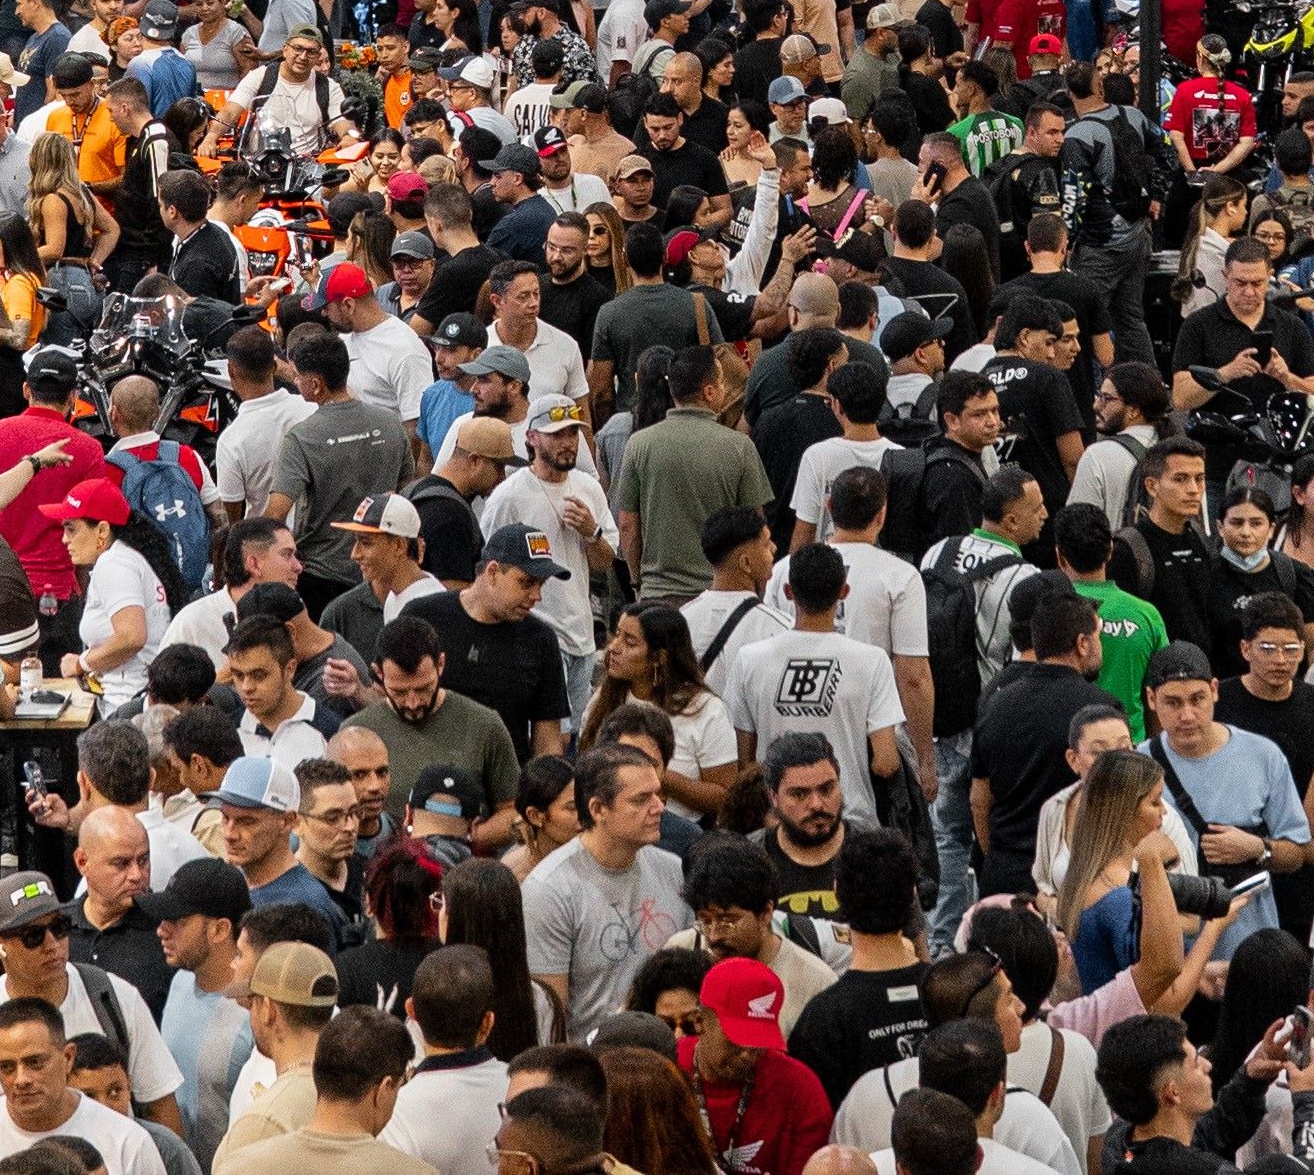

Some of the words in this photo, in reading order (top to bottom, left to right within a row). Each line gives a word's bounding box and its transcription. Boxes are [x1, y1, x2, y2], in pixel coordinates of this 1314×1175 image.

[772, 663, 845, 718] BURBERRY
[869, 1026, 891, 1040] ONLY
[891, 1022, 907, 1034] FOR
